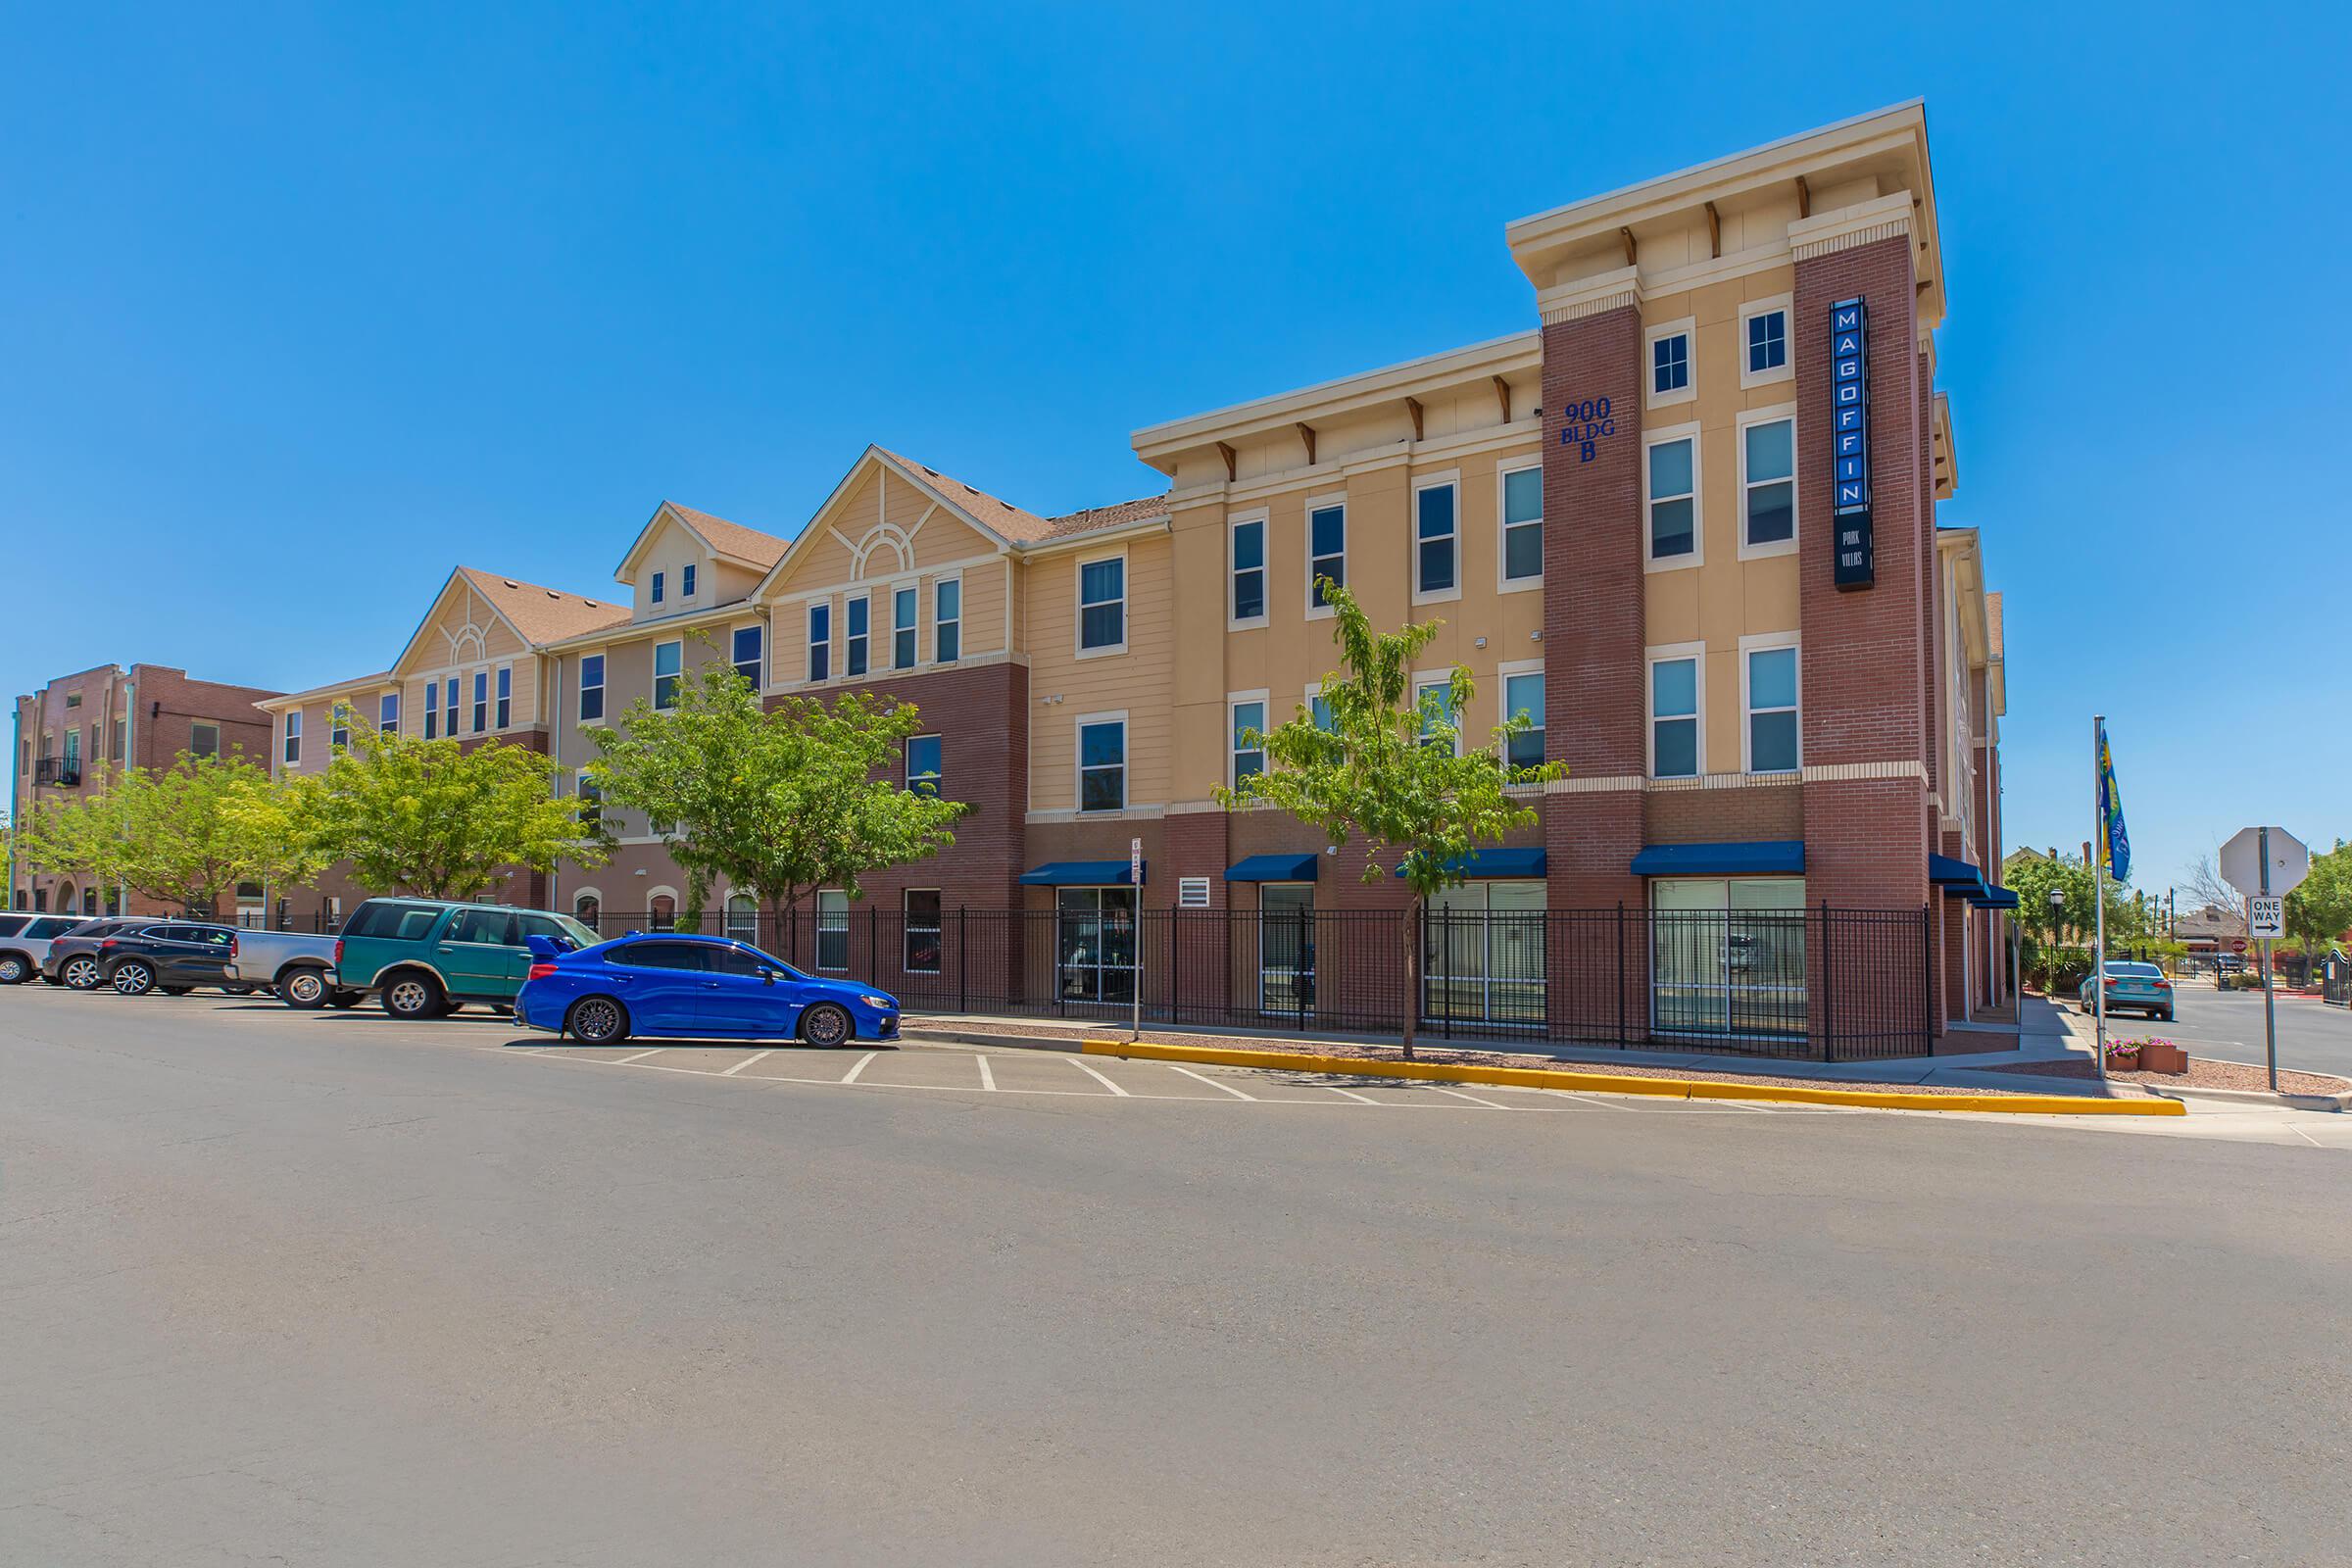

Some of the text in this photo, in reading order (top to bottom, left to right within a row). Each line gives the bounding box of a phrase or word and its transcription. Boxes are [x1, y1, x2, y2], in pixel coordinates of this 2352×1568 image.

[1565, 396, 1611, 424] 900
[1838, 311, 1859, 502] MAGOFFIN
[1560, 418, 1615, 445] BLDG
[1580, 440, 1596, 463] B
[1842, 530, 1860, 546] PARK
[1841, 551, 1863, 567] VILLAS
[2254, 901, 2279, 910] ONE
[2254, 912, 2280, 921] WAY
